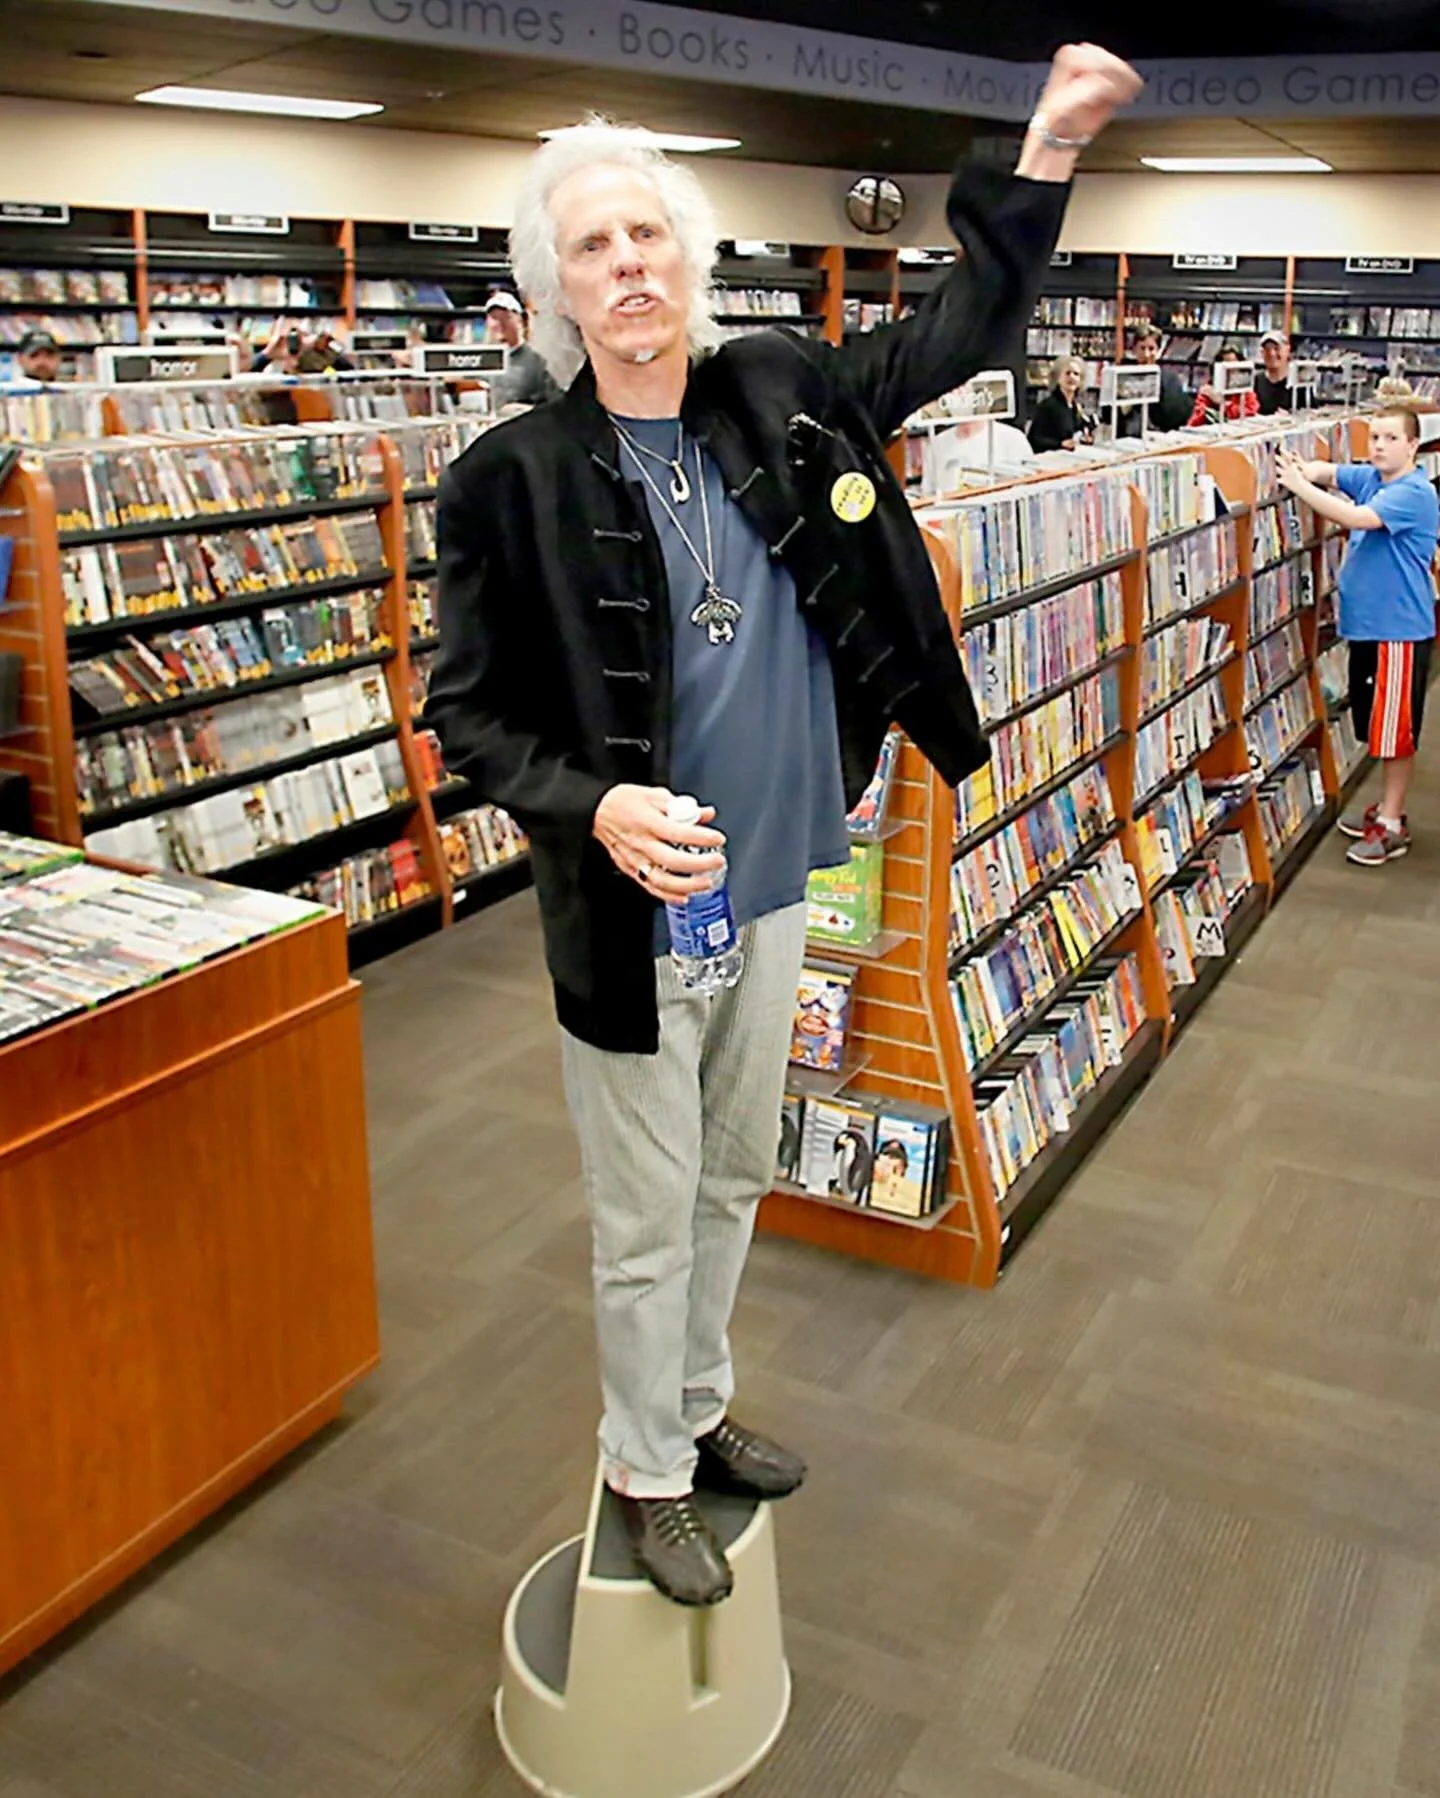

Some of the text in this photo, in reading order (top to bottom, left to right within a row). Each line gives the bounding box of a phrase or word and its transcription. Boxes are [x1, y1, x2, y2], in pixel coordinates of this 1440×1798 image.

[619, 12, 751, 70] Books
[793, 43, 905, 92] Music
[943, 66, 1046, 108] Movi
[150, 358, 198, 379] horror
[448, 353, 483, 368] horror
[1196, 922, 1222, 939] M
